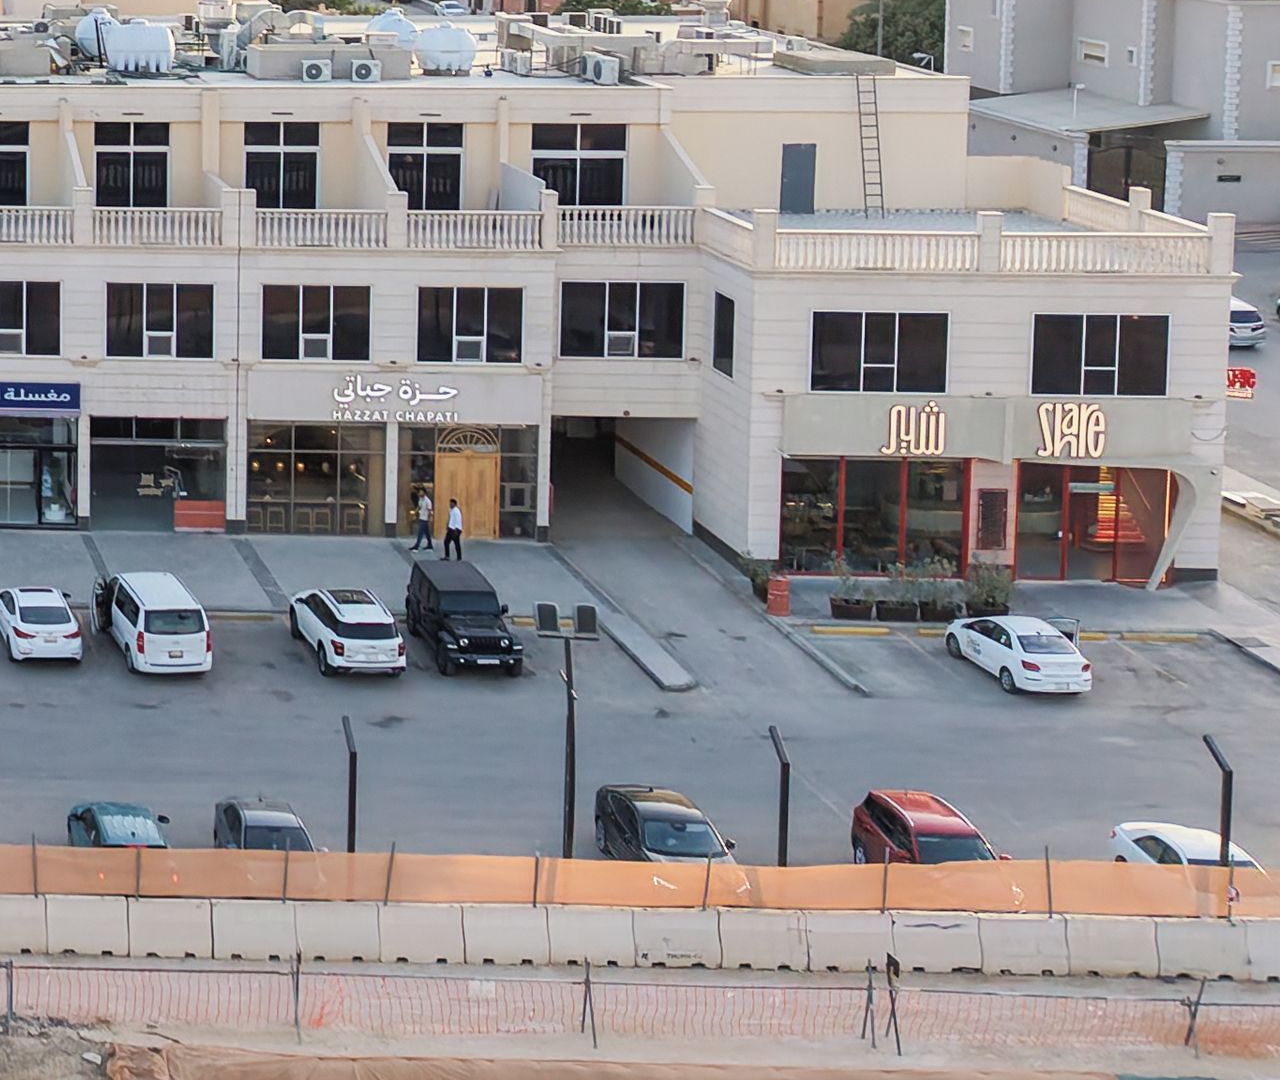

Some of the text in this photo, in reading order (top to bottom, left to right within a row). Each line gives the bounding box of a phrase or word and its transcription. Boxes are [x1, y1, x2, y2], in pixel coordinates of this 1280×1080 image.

[4, 387, 71, 402] مغسلة
[333, 374, 458, 408] حزة جباتي
[332, 410, 459, 422] HAZZAT CHAPATI
